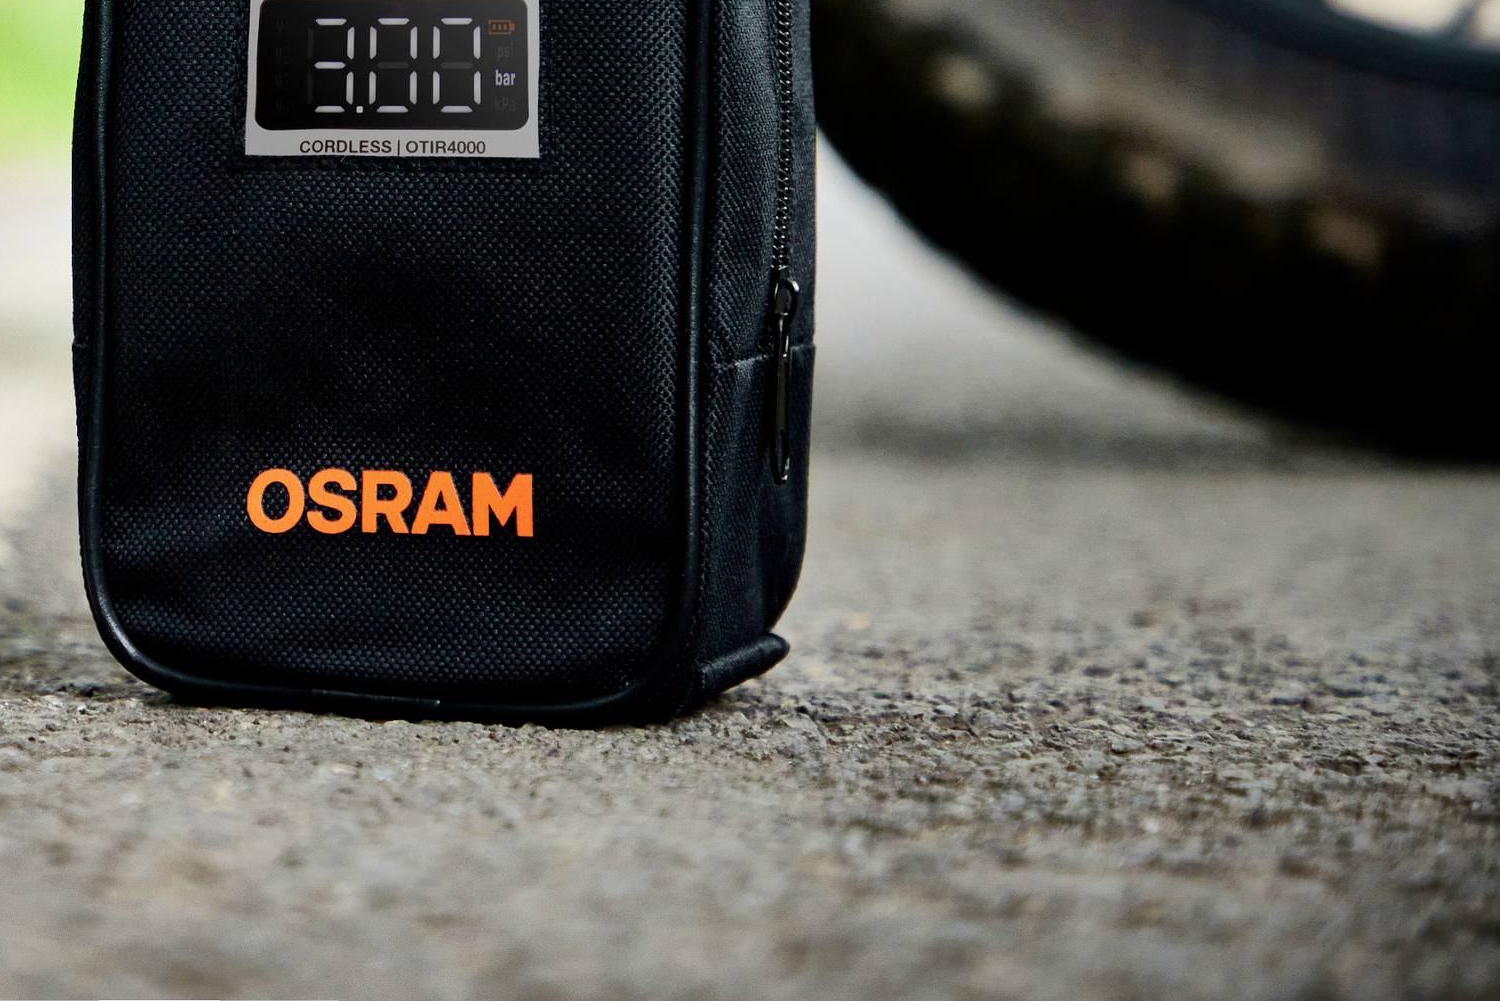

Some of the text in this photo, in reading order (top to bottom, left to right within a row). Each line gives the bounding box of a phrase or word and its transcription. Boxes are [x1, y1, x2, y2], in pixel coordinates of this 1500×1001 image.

[315, 18, 481, 114] 3.00
[495, 69, 516, 86] bar
[299, 139, 392, 154] CORDLESS
[405, 140, 486, 155] OTIR4000
[246, 467, 534, 538] OSRAM
